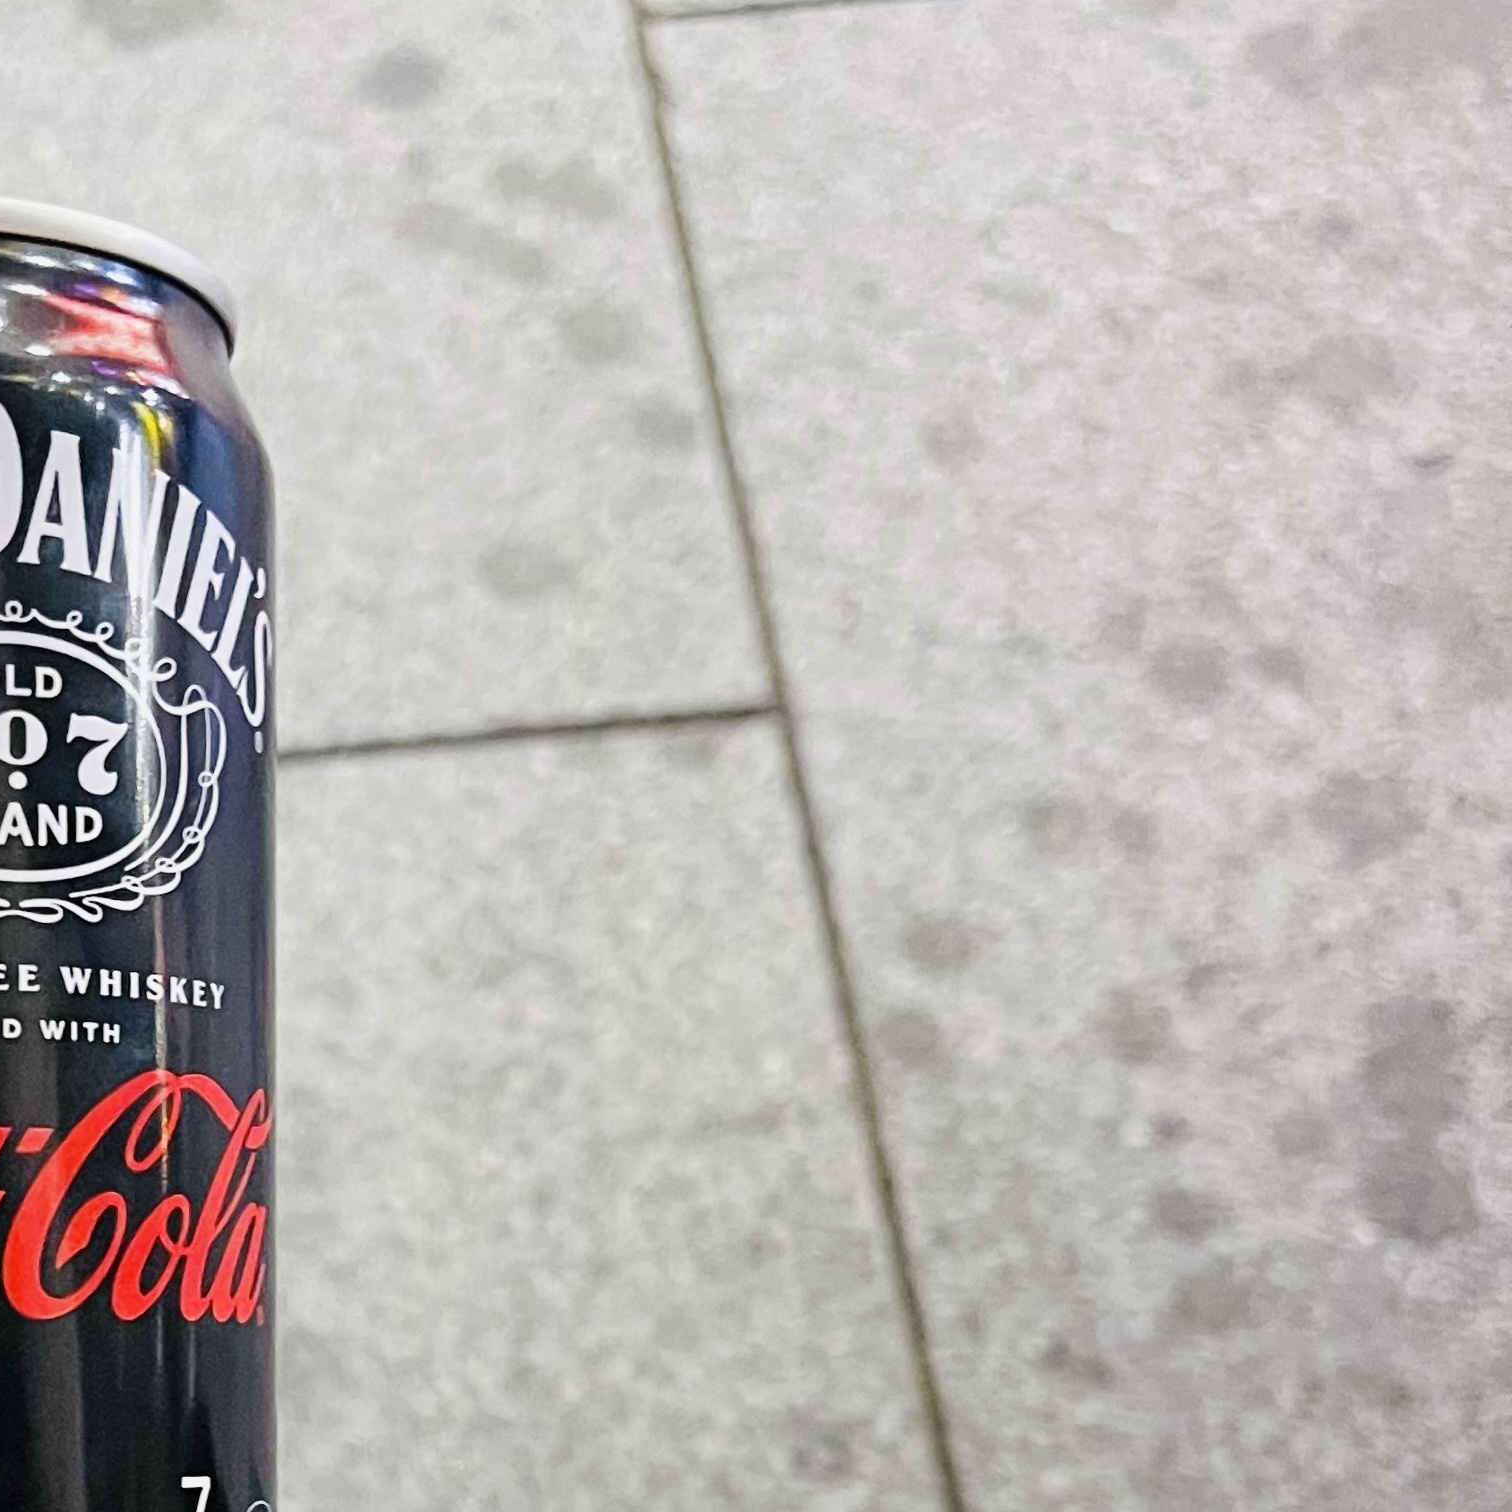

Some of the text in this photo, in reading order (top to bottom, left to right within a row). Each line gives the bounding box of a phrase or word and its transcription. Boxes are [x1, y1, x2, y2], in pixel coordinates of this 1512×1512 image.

[66, 712, 129, 796] 7
[59, 965, 226, 1010] WHISKEY
[39, 1019, 121, 1044] WITH
